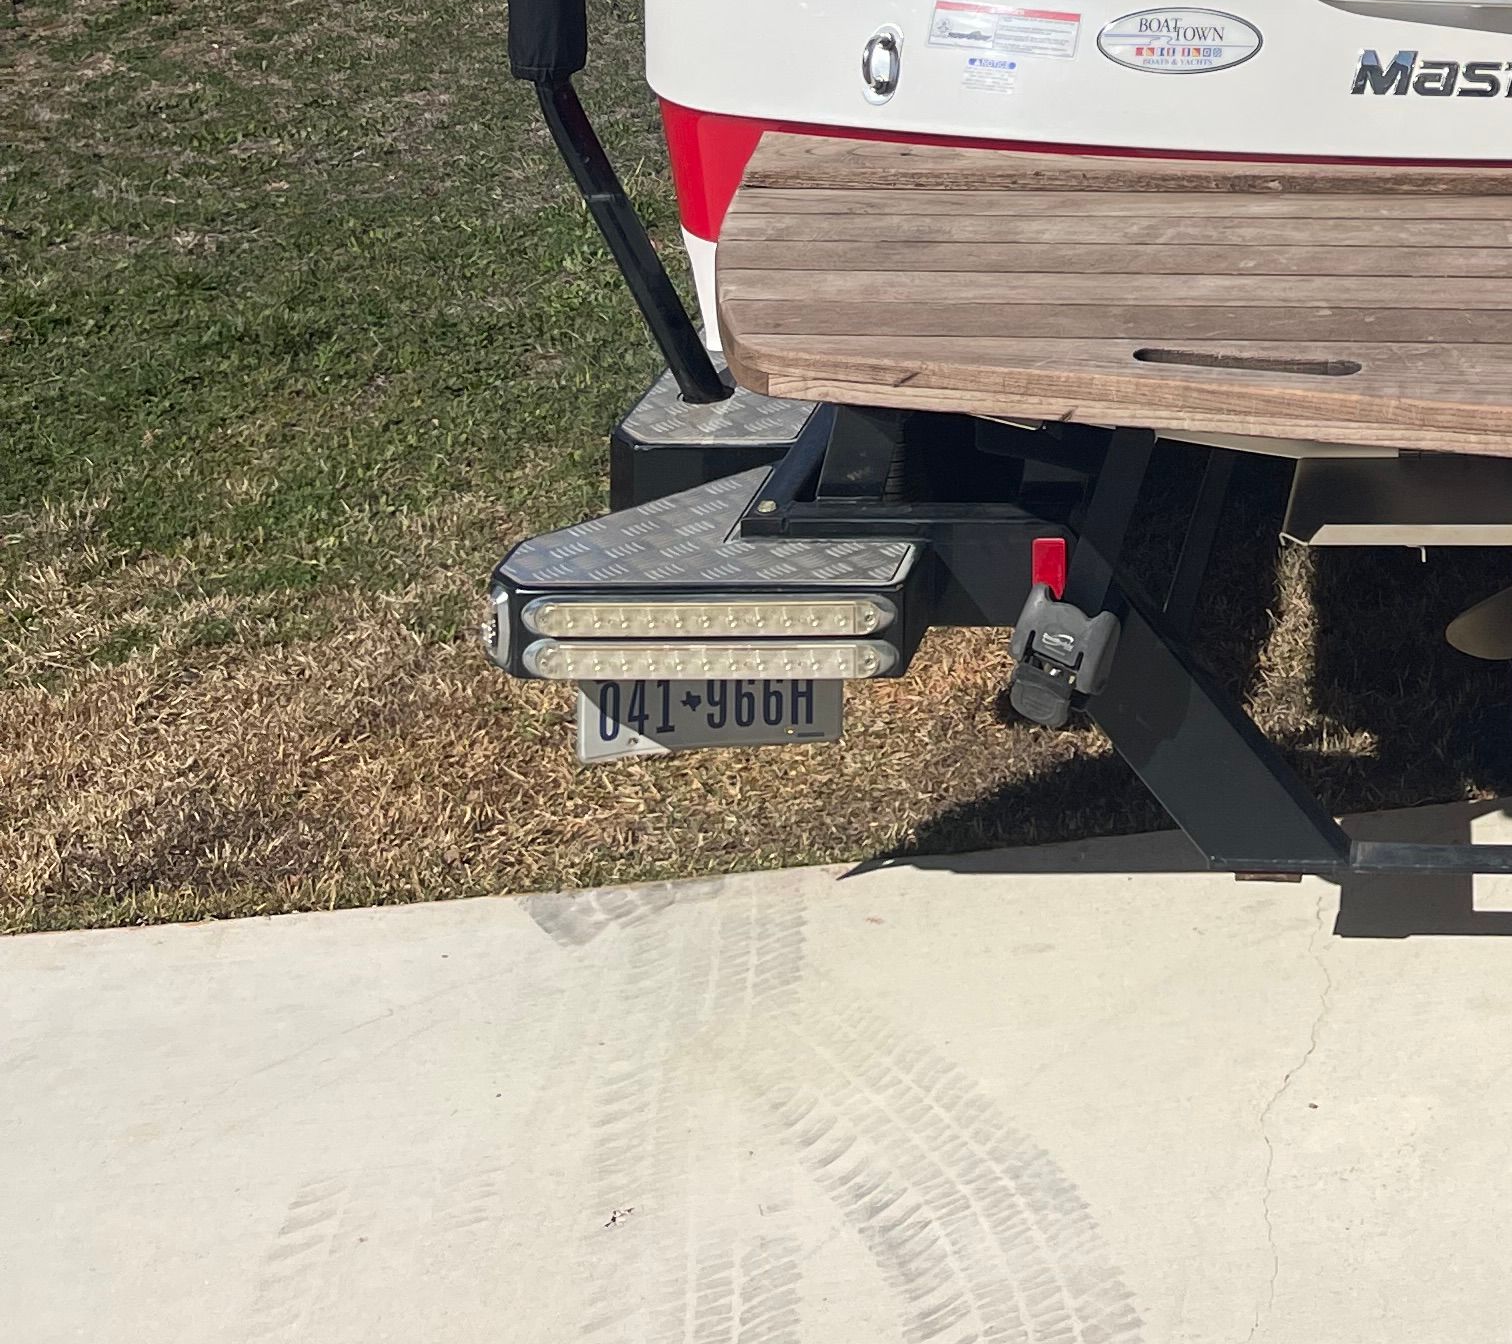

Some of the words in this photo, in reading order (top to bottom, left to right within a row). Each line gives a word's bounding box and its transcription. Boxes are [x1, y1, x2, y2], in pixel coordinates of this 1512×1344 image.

[1139, 17, 1183, 32] BOAT
[1175, 26, 1225, 42] TOWN
[599, 679, 675, 742] 041
[706, 679, 814, 729] 966H
